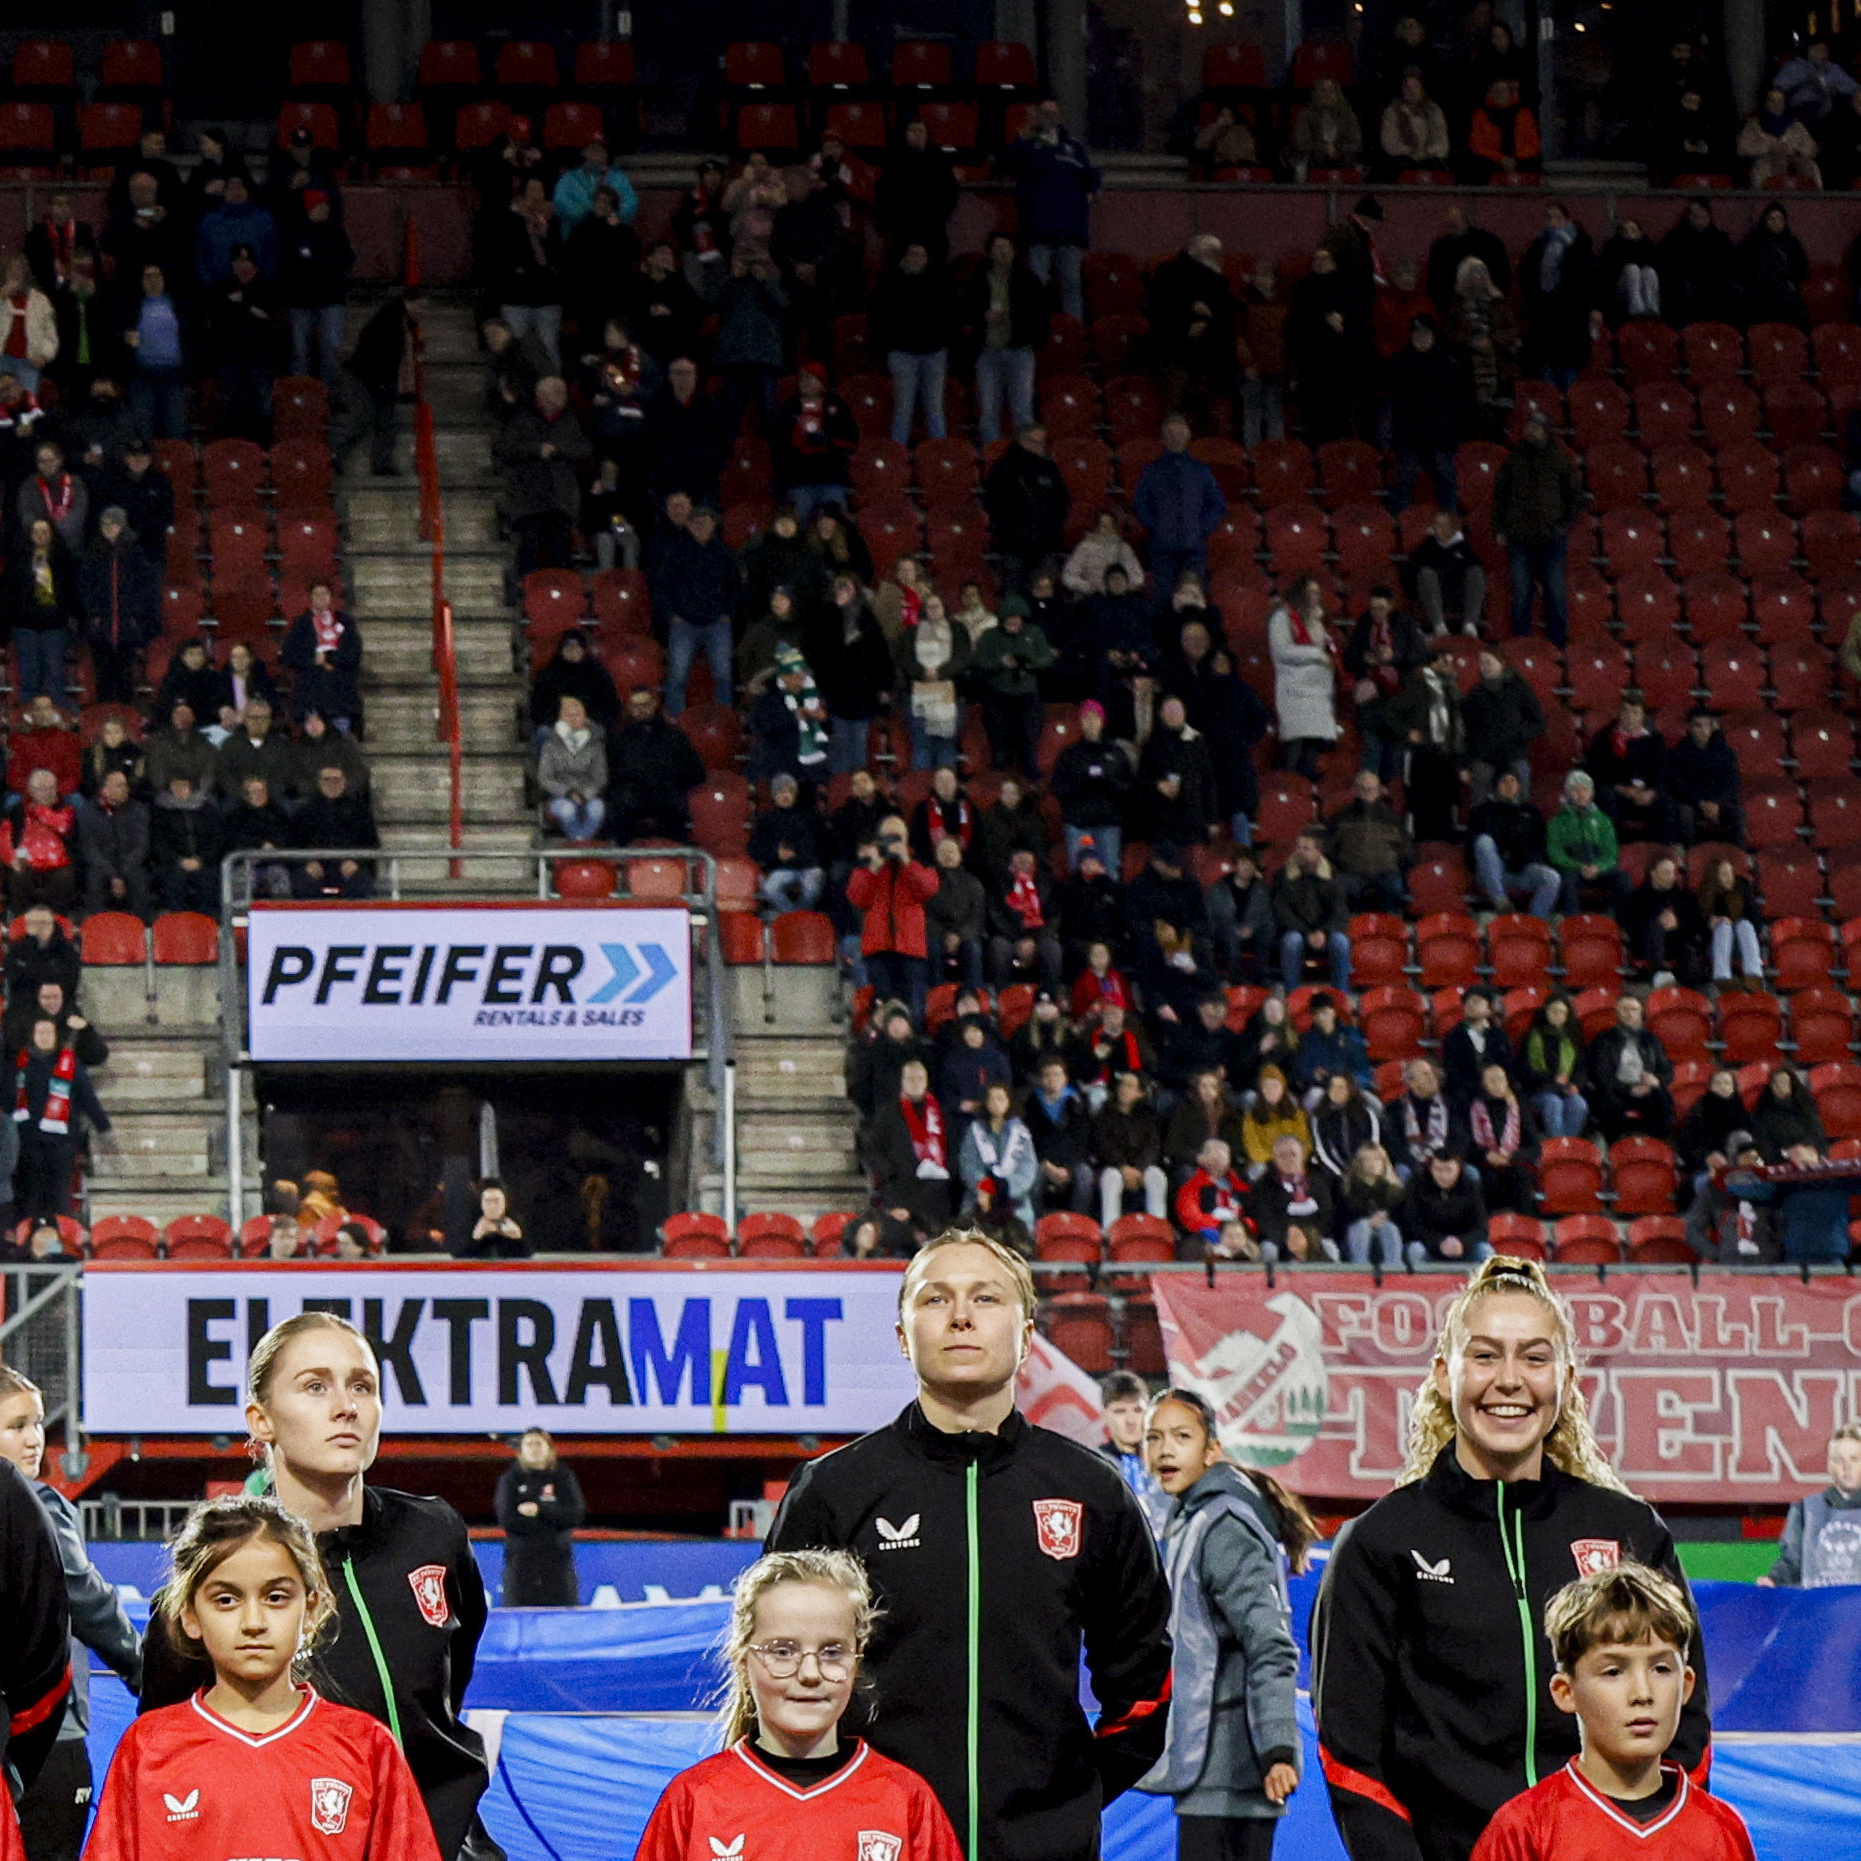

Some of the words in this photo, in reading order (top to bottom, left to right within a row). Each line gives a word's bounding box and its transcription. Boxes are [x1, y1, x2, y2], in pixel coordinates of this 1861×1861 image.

[261, 943, 586, 1006] PFEIFER
[474, 1010, 562, 1027] RENTALS
[582, 1010, 647, 1027] SALES
[186, 1297, 844, 1407] EKTRAMAT
